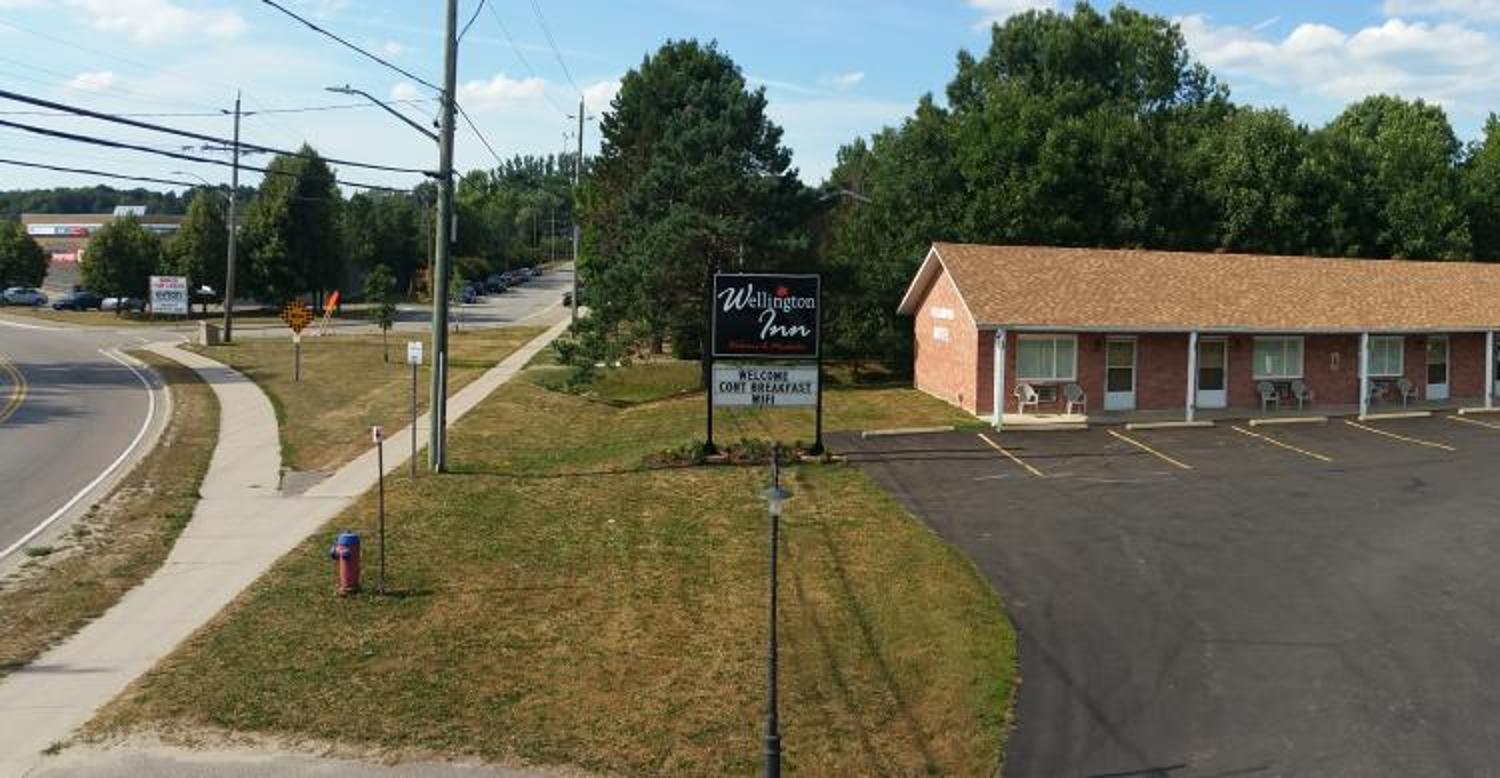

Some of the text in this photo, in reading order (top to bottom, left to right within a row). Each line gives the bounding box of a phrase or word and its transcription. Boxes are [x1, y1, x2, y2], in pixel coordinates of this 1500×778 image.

[717, 283, 815, 313] Wellington
[759, 308, 811, 340] Inn
[739, 370, 788, 380] WELCOME
[720, 381, 811, 393] CONT BREAKFAST
[751, 394, 775, 404] WIFI
